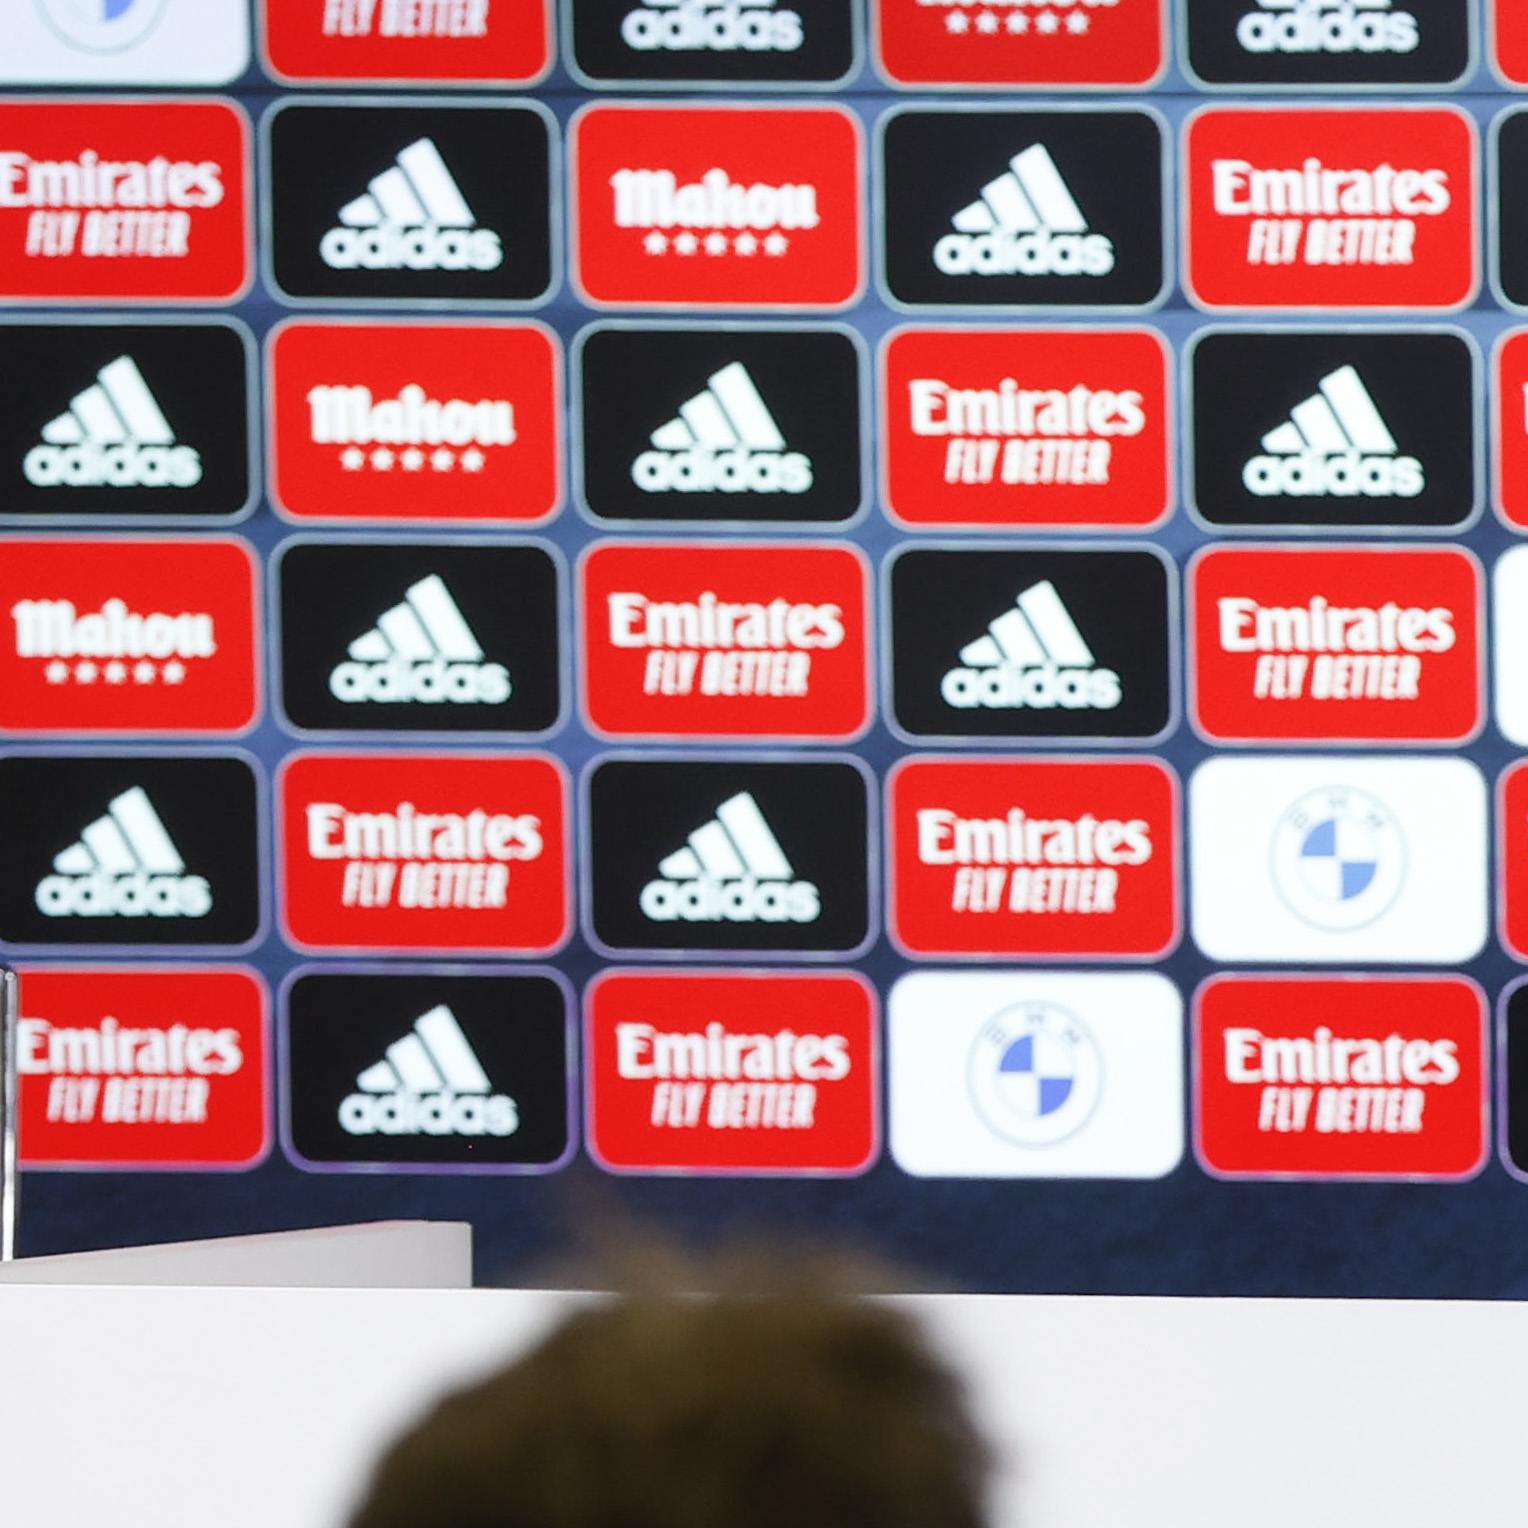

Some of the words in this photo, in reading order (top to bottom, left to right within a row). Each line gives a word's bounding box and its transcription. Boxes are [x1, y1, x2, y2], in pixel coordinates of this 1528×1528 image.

[622, 1, 803, 50] adidas
[1237, 3, 1419, 52] adidas
[0, 151, 223, 207] Emirates
[611, 168, 819, 229] Mahou
[1212, 158, 1450, 215] Emirates
[27, 211, 80, 256] FLY
[82, 211, 190, 256] BETTER
[320, 221, 502, 270] adidas
[934, 226, 1114, 275] adidas
[1248, 219, 1302, 264] FLY
[1305, 219, 1415, 265] BETTER
[307, 385, 516, 445] Mahou
[909, 378, 1145, 436] Emirates
[24, 438, 201, 486] adidas
[632, 444, 813, 493] adidas
[945, 439, 1000, 484] FLY
[1002, 439, 1110, 484] BETTER
[1243, 447, 1424, 496] adidas
[12, 599, 215, 658] Mahou
[608, 592, 844, 648] Emirates
[1218, 596, 1455, 652] Emirates
[330, 654, 511, 703] adidas
[645, 650, 698, 695] FLY
[701, 651, 810, 696] BETTER
[941, 659, 1121, 708] adidas
[1254, 655, 1308, 699] FLY
[1311, 655, 1420, 699] BETTER
[307, 803, 542, 860] Emirates
[917, 808, 1151, 865] Emirates
[36, 869, 211, 916] adidas
[343, 862, 396, 906] FLY
[400, 862, 508, 908] BETTER
[640, 873, 820, 922] adidas
[953, 867, 1006, 912] FLY
[1009, 867, 1117, 913] BETTER
[616, 1023, 850, 1080] Emirates
[1224, 1027, 1459, 1084] Emirates
[48, 1077, 99, 1122] FLY
[103, 1077, 208, 1123] BETTER
[339, 1087, 518, 1135] adidas
[652, 1082, 705, 1127] FLY
[708, 1082, 816, 1128] BETTER
[1259, 1087, 1312, 1131] FLY
[1316, 1087, 1424, 1132] BETTER
